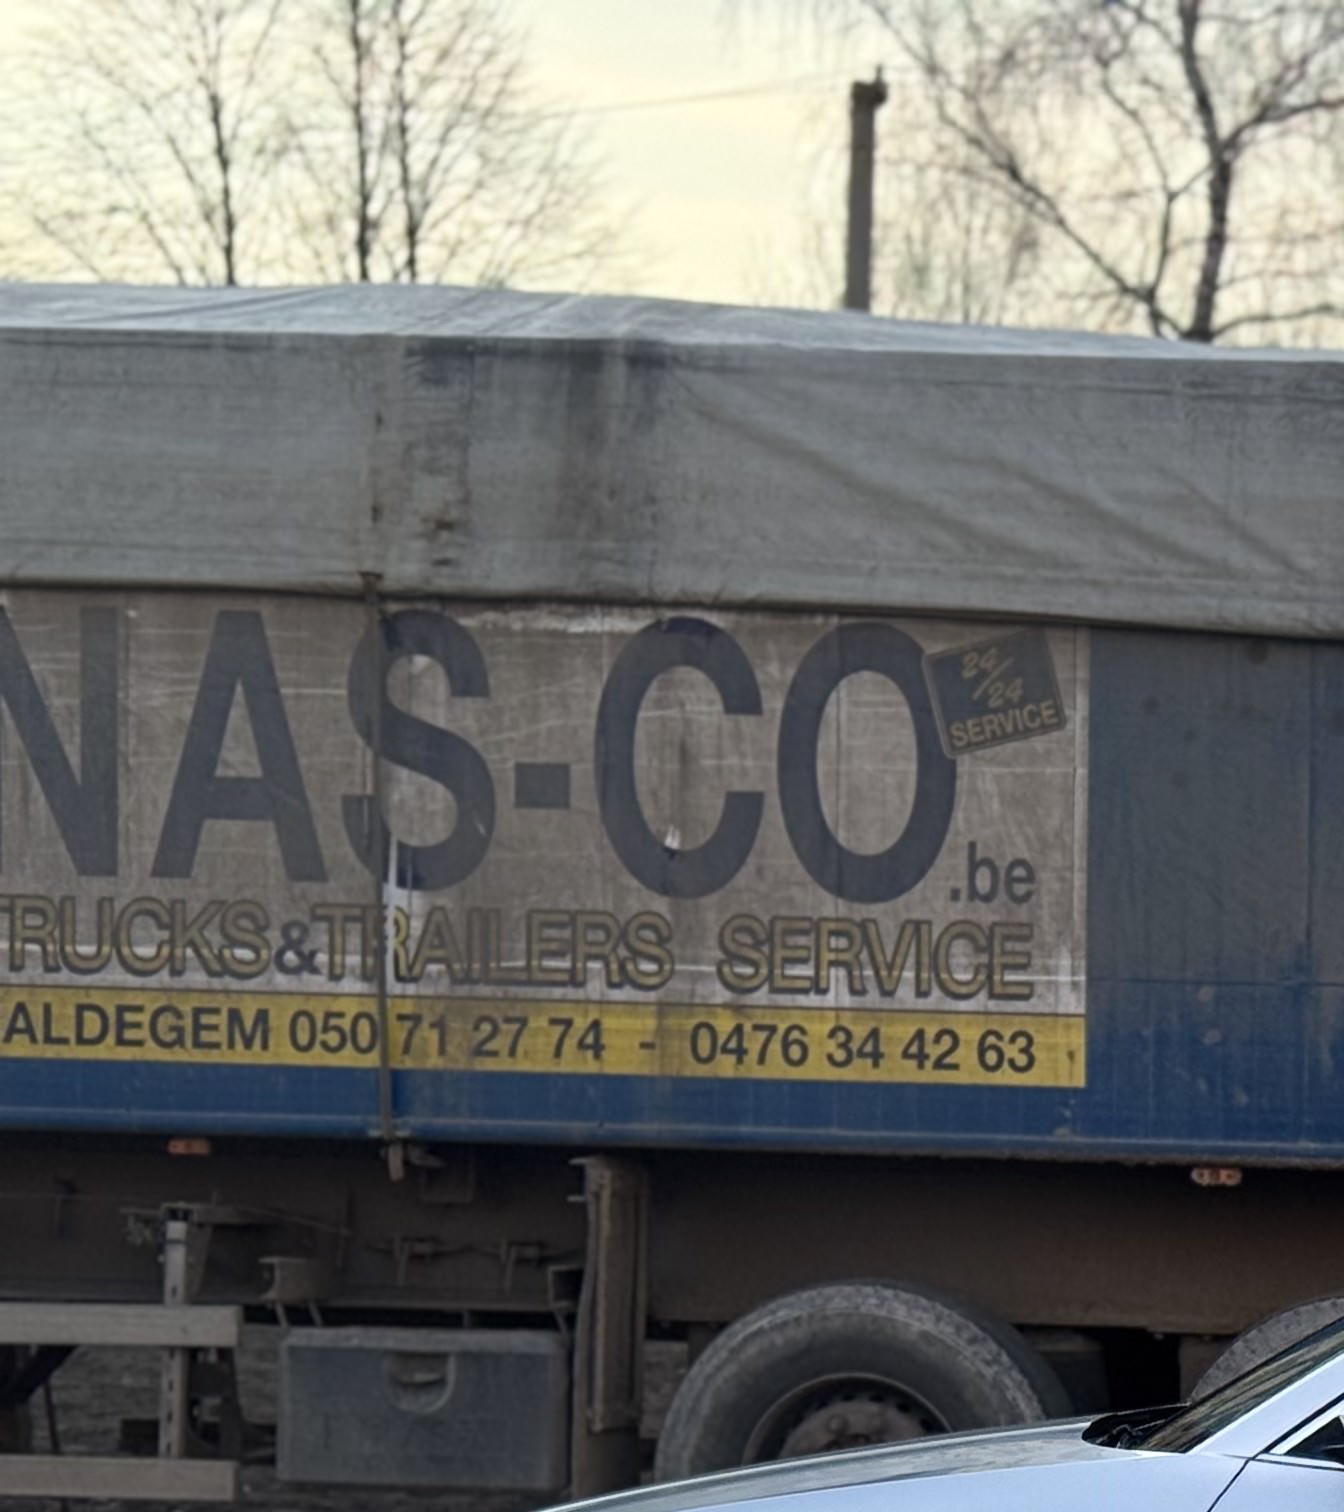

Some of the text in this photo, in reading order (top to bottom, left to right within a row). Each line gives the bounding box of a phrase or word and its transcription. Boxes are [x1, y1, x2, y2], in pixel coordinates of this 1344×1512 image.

[950, 700, 1060, 748] SERVICE
[0, 893, 1035, 1001] RUCKS&TRAILERS SERVICE
[2, 1001, 1037, 1074] ALDEGEM 050 71 27 74 - 0476 34 42 63
